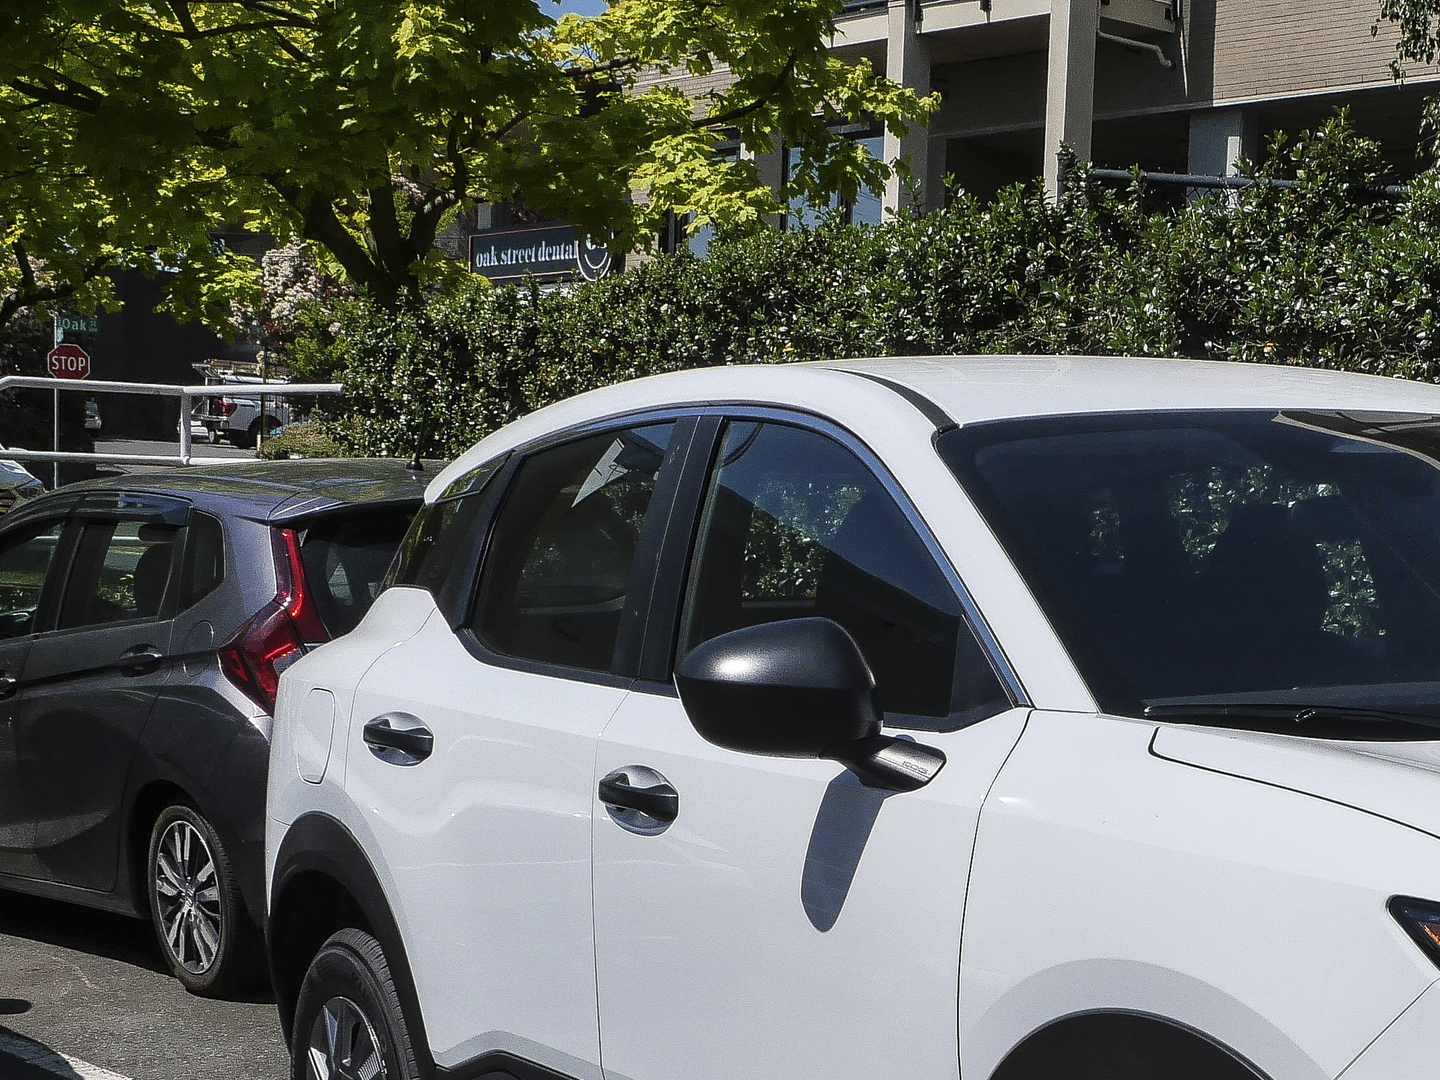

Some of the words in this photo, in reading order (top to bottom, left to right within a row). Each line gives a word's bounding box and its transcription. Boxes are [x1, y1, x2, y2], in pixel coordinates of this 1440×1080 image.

[475, 246, 500, 268] oak
[500, 243, 536, 265] street
[537, 240, 579, 263] dental
[62, 318, 87, 331] Oak
[51, 355, 86, 371] STOP
